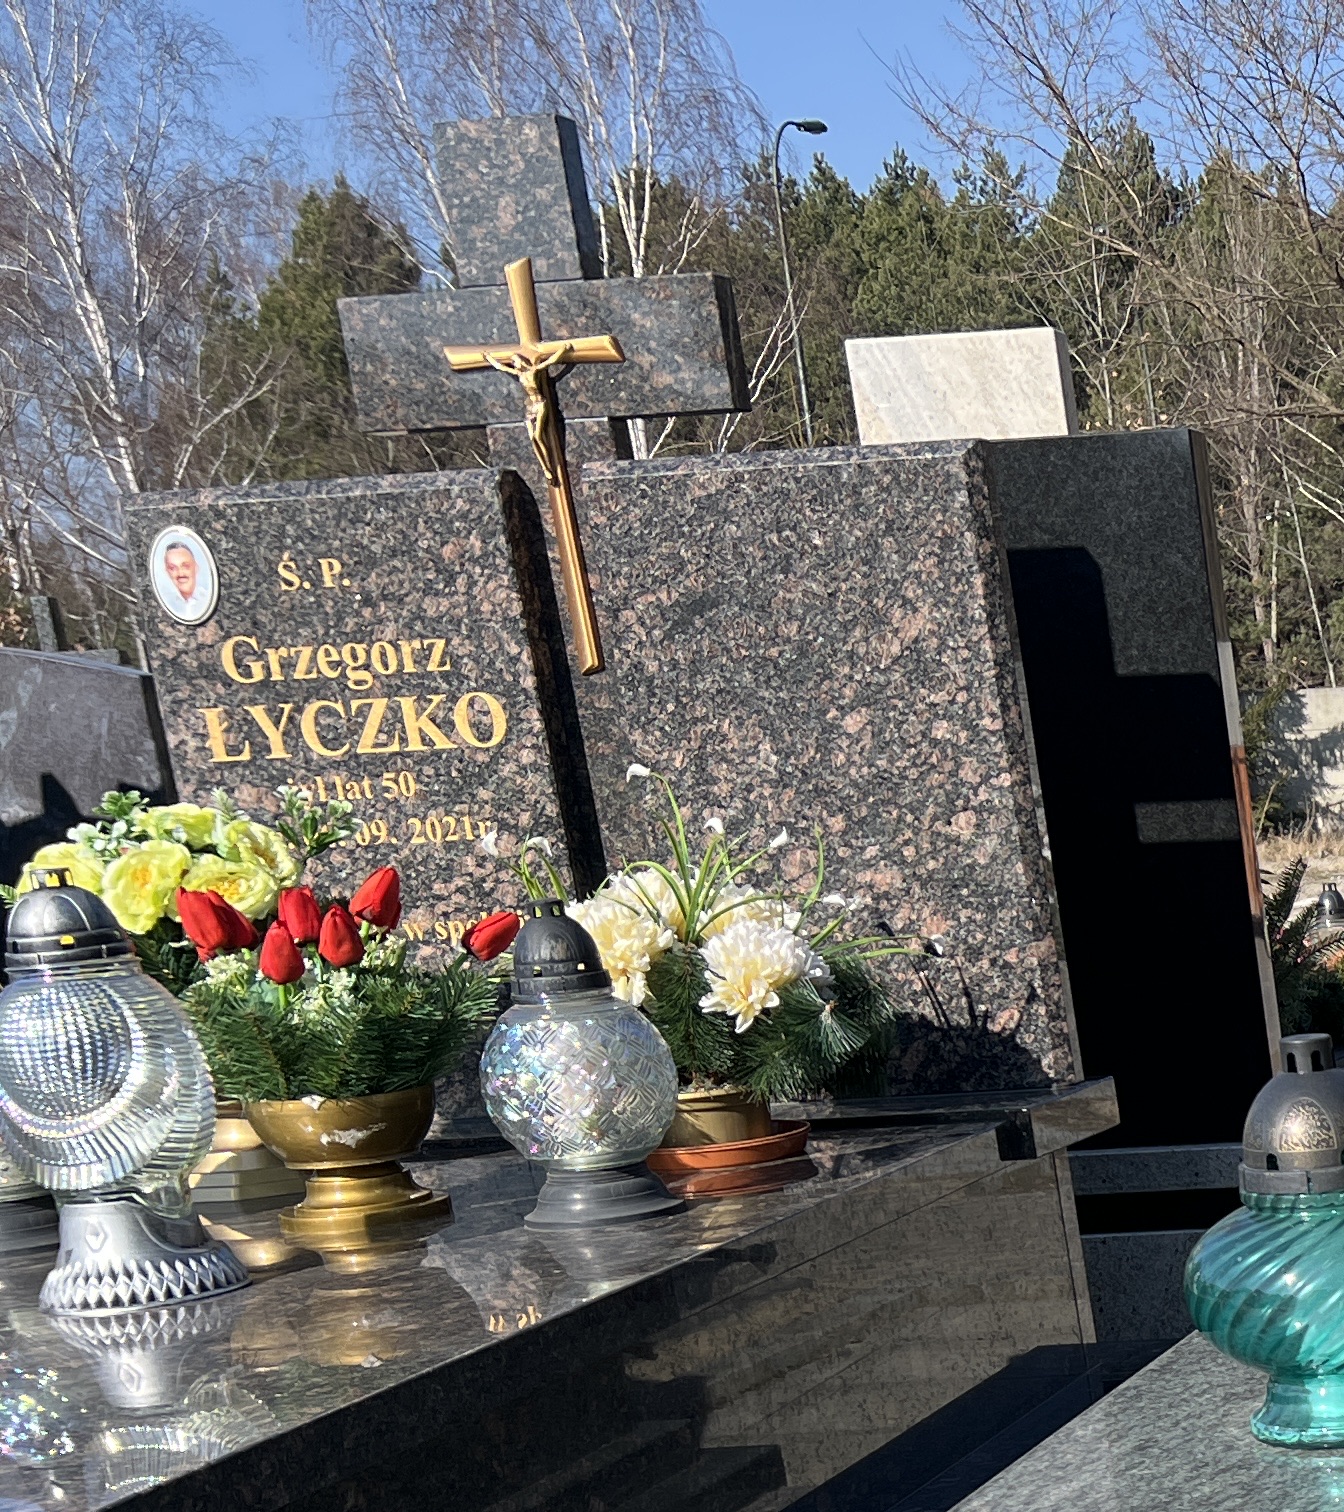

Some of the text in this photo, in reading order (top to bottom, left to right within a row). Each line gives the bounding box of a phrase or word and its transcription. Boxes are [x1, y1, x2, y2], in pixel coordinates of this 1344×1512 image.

[220, 635, 451, 691] Grzegorz
[198, 691, 508, 763] ŁYCZKO
[334, 775, 375, 801] lat
[382, 770, 417, 800] 50
